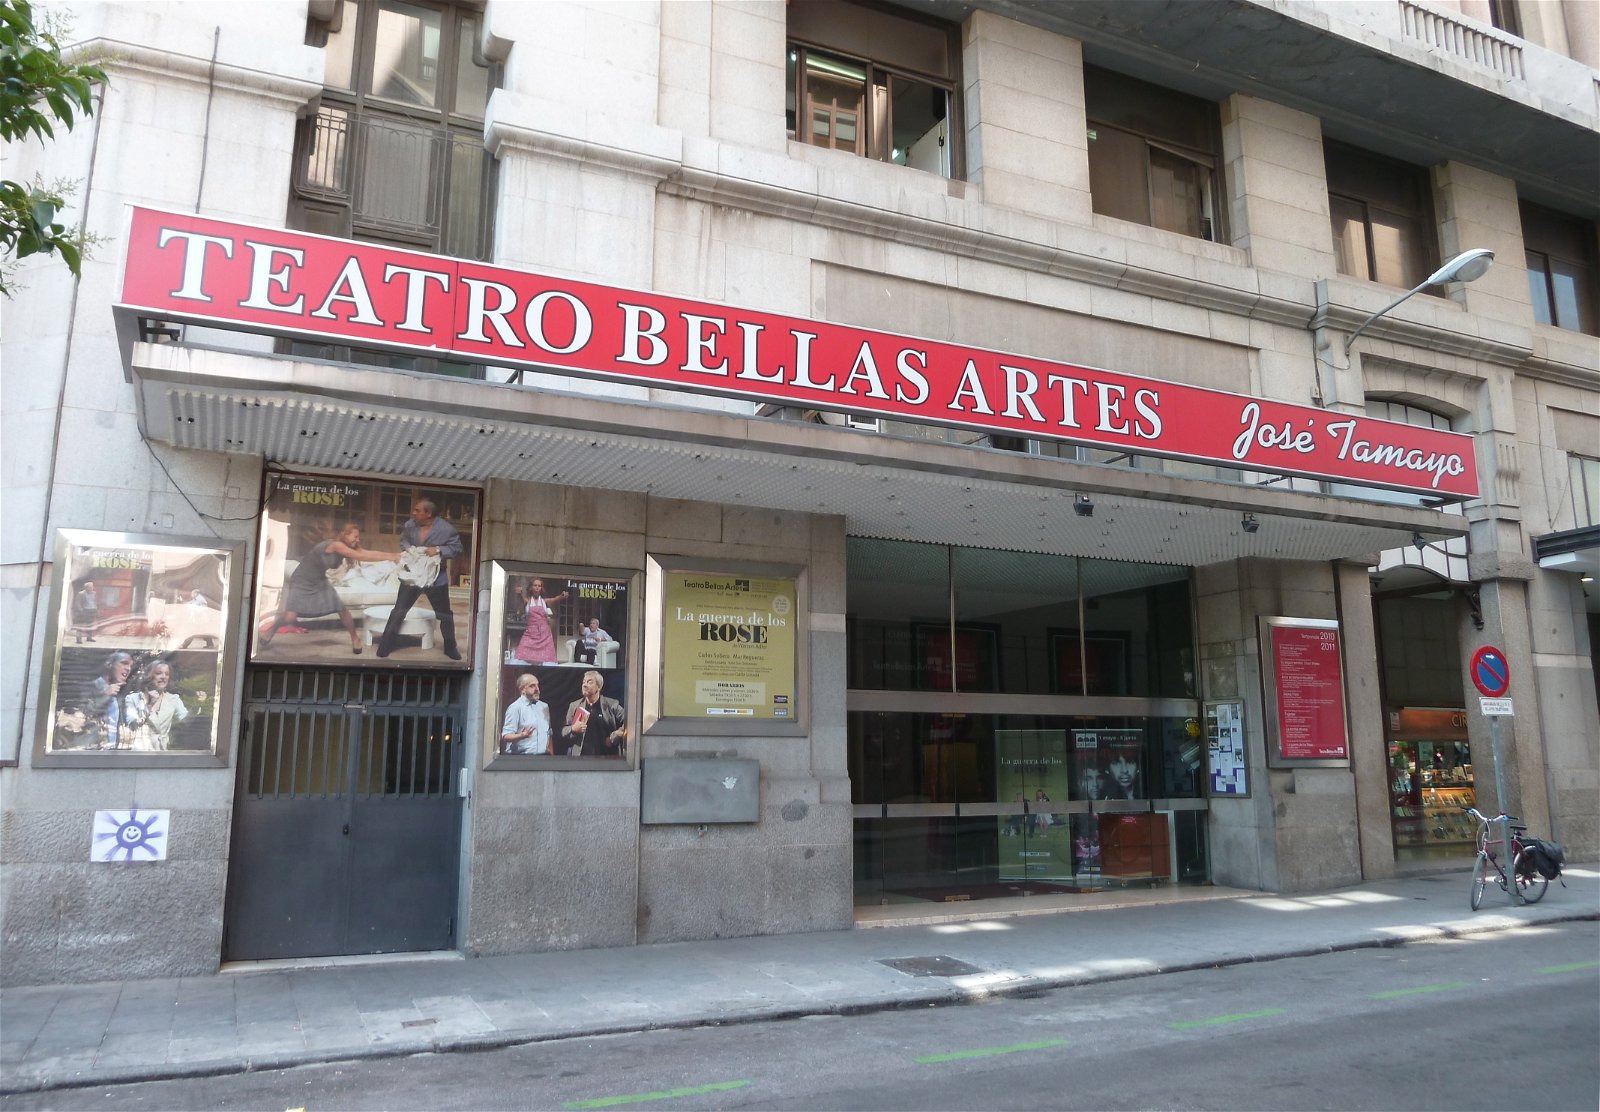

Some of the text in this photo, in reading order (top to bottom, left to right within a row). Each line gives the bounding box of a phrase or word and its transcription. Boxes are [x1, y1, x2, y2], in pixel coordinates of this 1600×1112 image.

[158, 226, 1163, 441] TEATRO BELLAS ARTES
[1232, 402, 1465, 489] José Tamayo
[276, 481, 359, 496] La guerra de los
[291, 490, 345, 506] ROSE
[92, 557, 141, 570] ROSE
[567, 580, 577, 588] La
[578, 582, 604, 590] guerra
[615, 583, 626, 591] los
[578, 588, 616, 600] ROSE
[676, 607, 694, 622] La
[698, 611, 744, 625] guerra
[748, 611, 764, 625] de
[768, 611, 786, 627] los
[698, 622, 768, 644] ROSE
[1320, 631, 1335, 641] 2010
[1321, 642, 1335, 651] 2011
